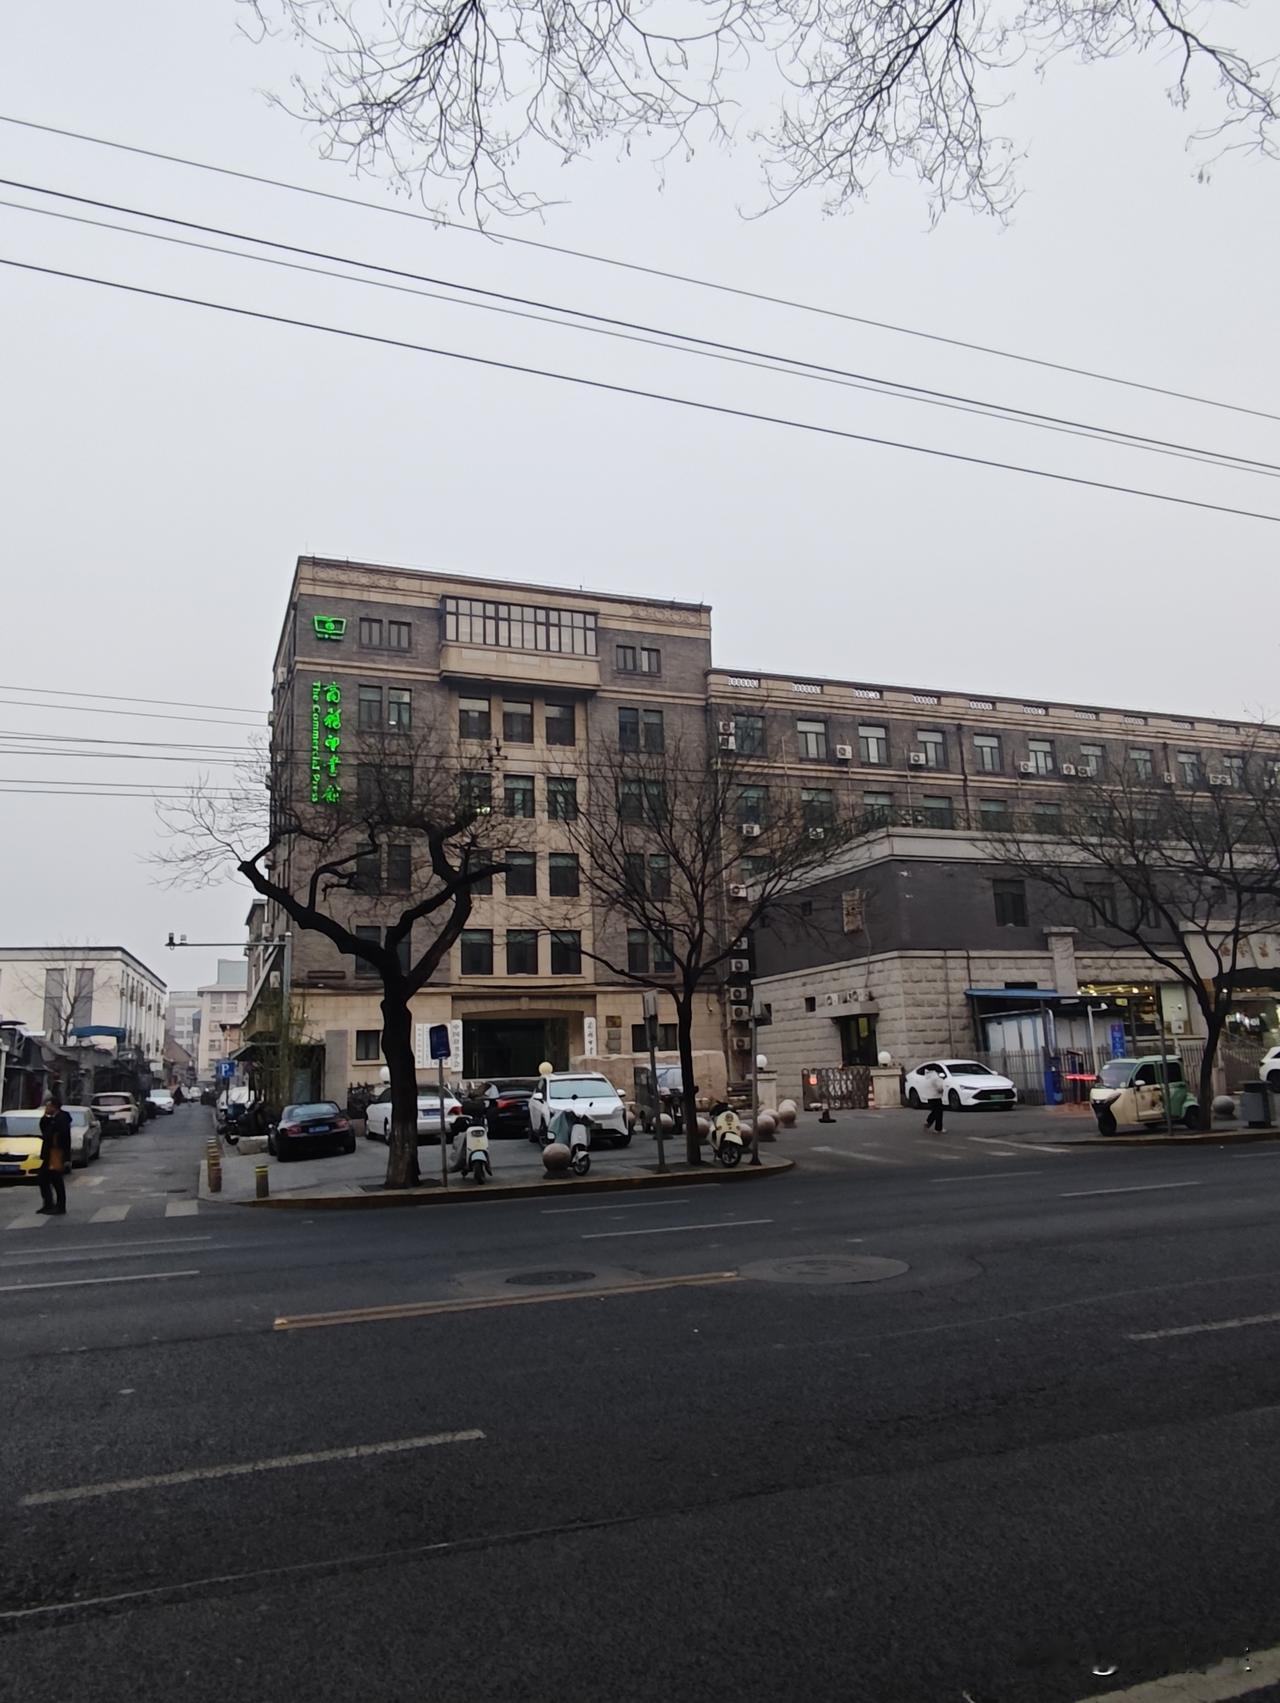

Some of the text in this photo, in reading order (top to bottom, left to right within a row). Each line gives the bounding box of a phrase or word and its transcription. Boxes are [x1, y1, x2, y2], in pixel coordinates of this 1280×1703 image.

[312, 680, 321, 802] The Commercial Press
[221, 1063, 230, 1077] P
